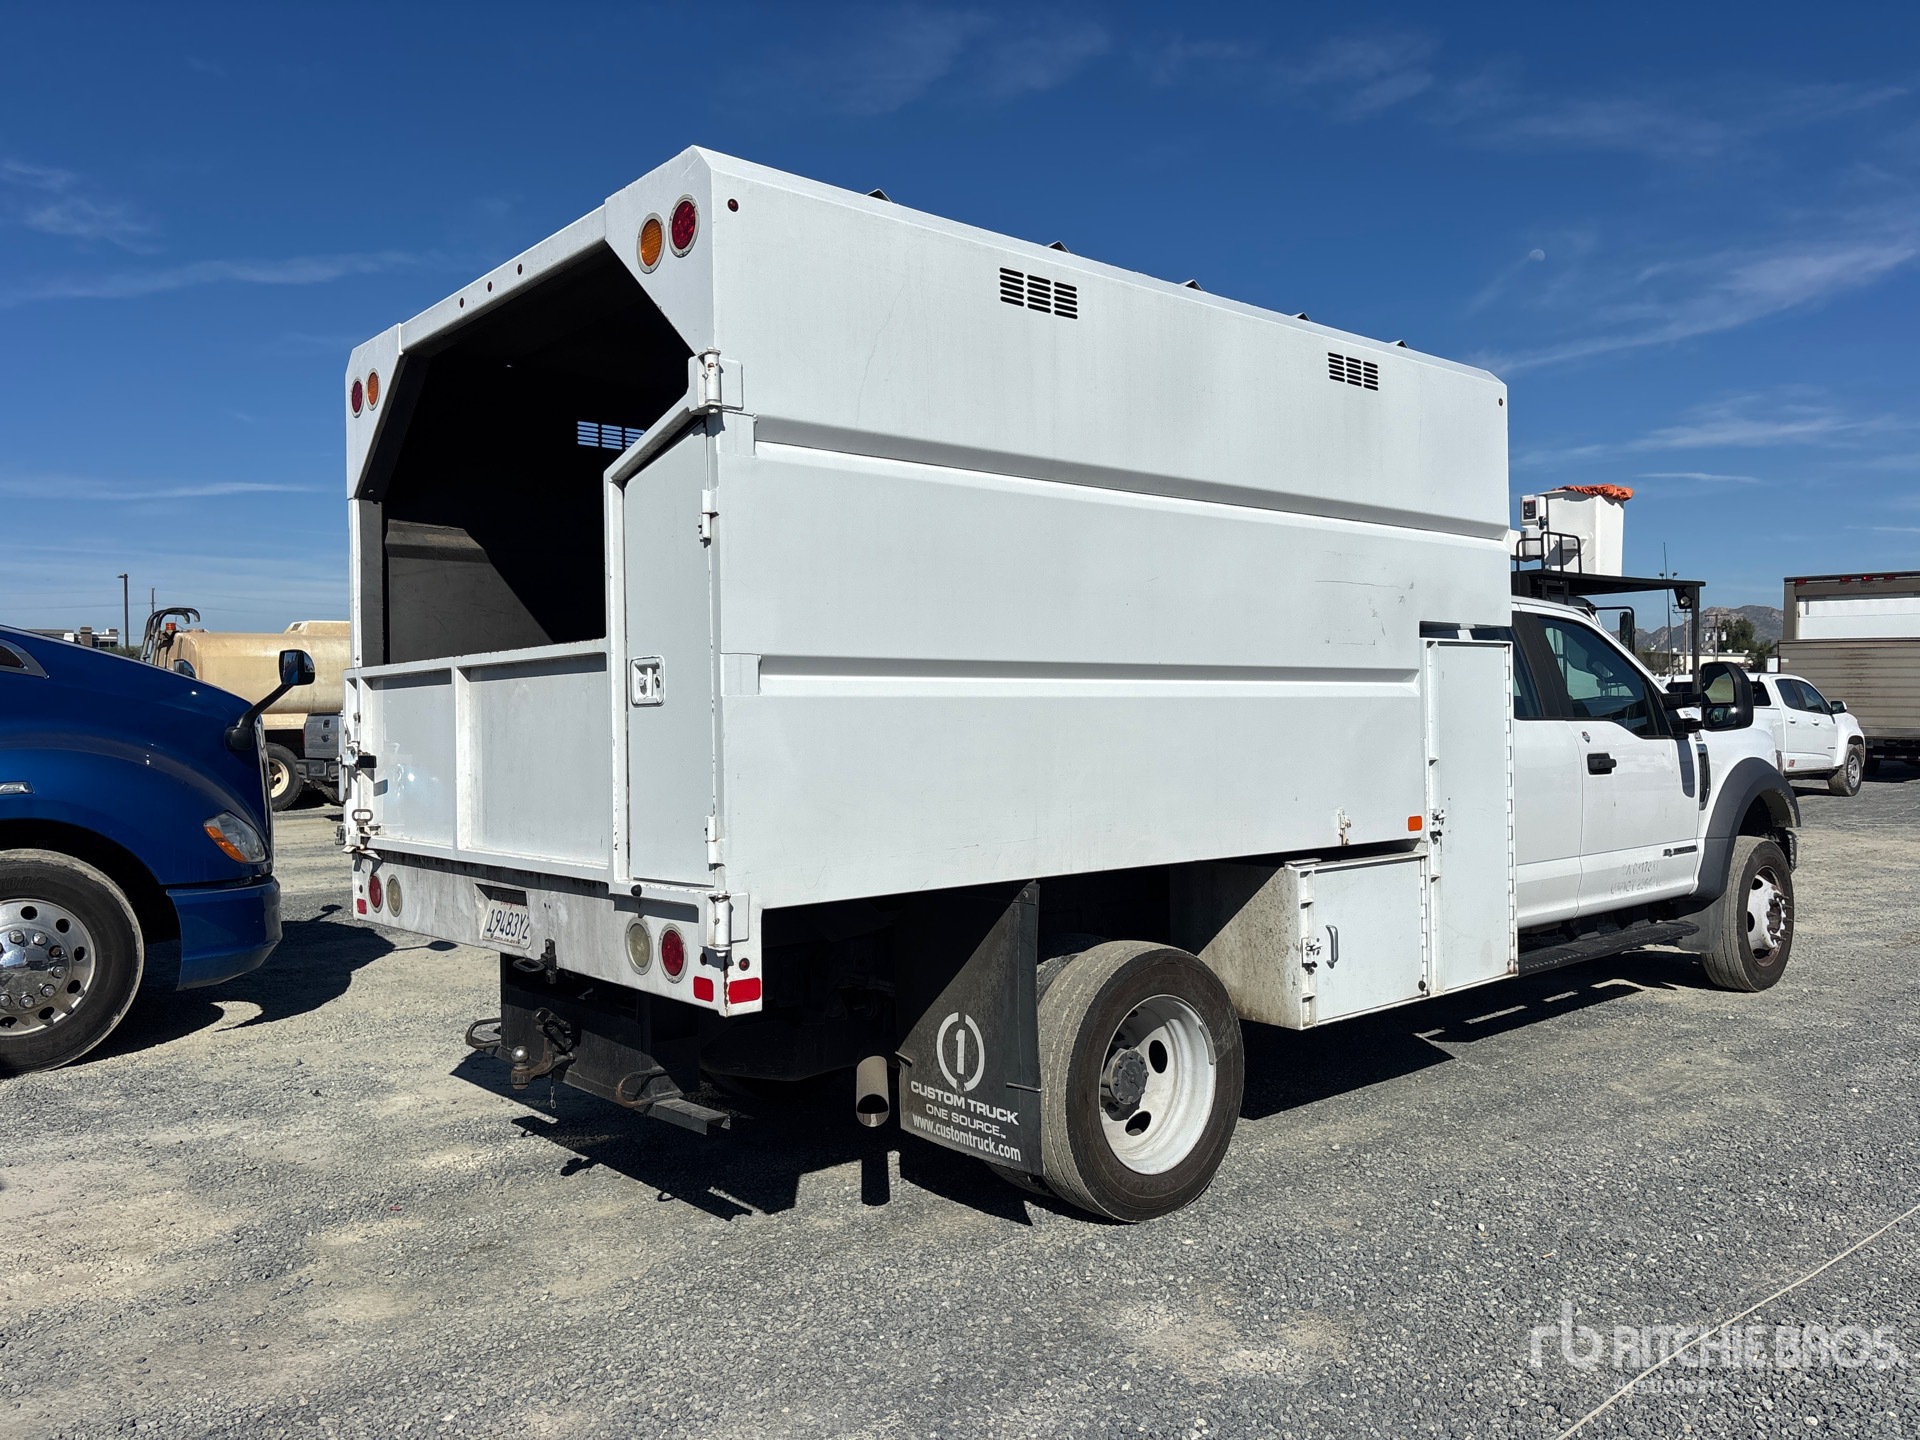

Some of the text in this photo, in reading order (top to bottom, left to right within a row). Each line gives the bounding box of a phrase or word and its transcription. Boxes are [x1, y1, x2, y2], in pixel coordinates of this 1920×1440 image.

[910, 1080, 1020, 1126] CUSTOM TRUCK
[925, 1103, 949, 1121] ONE
[912, 1113, 1022, 1162] www.customtruck.com
